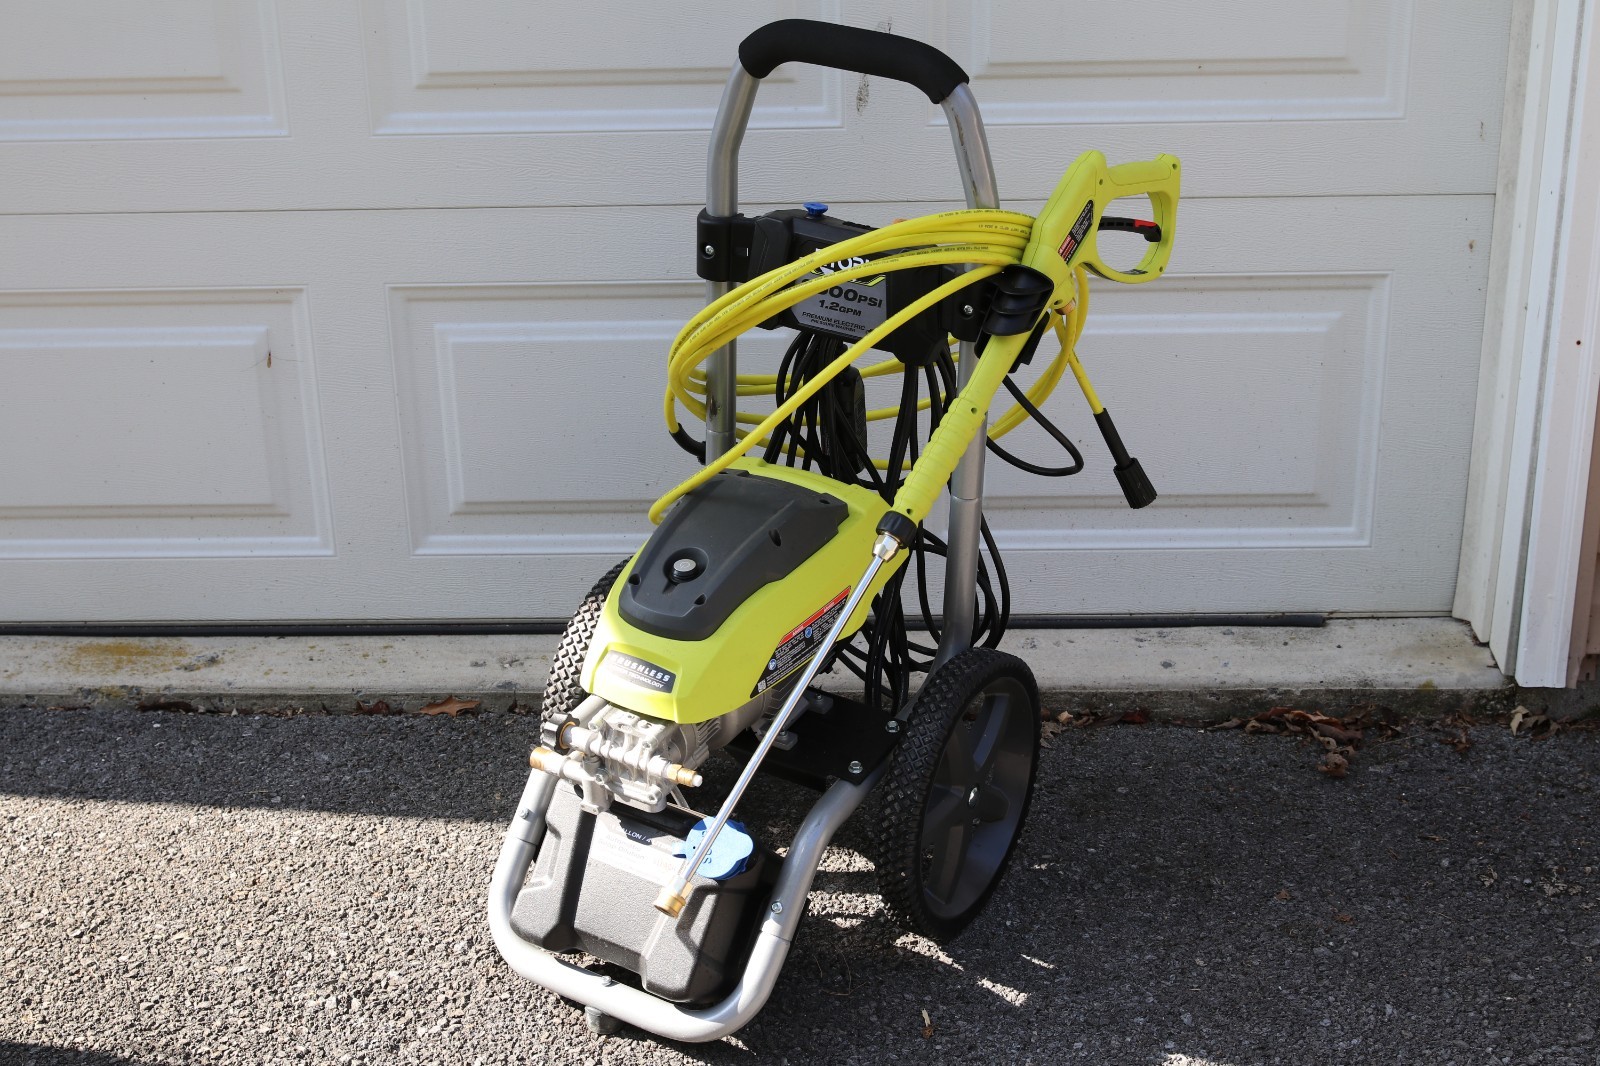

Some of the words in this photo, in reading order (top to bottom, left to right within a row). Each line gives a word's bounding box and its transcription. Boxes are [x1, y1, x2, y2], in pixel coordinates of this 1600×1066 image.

[819, 299, 862, 317] 1.2GPM
[802, 311, 833, 323] PREMIUM
[833, 318, 866, 331] ELECTRIC
